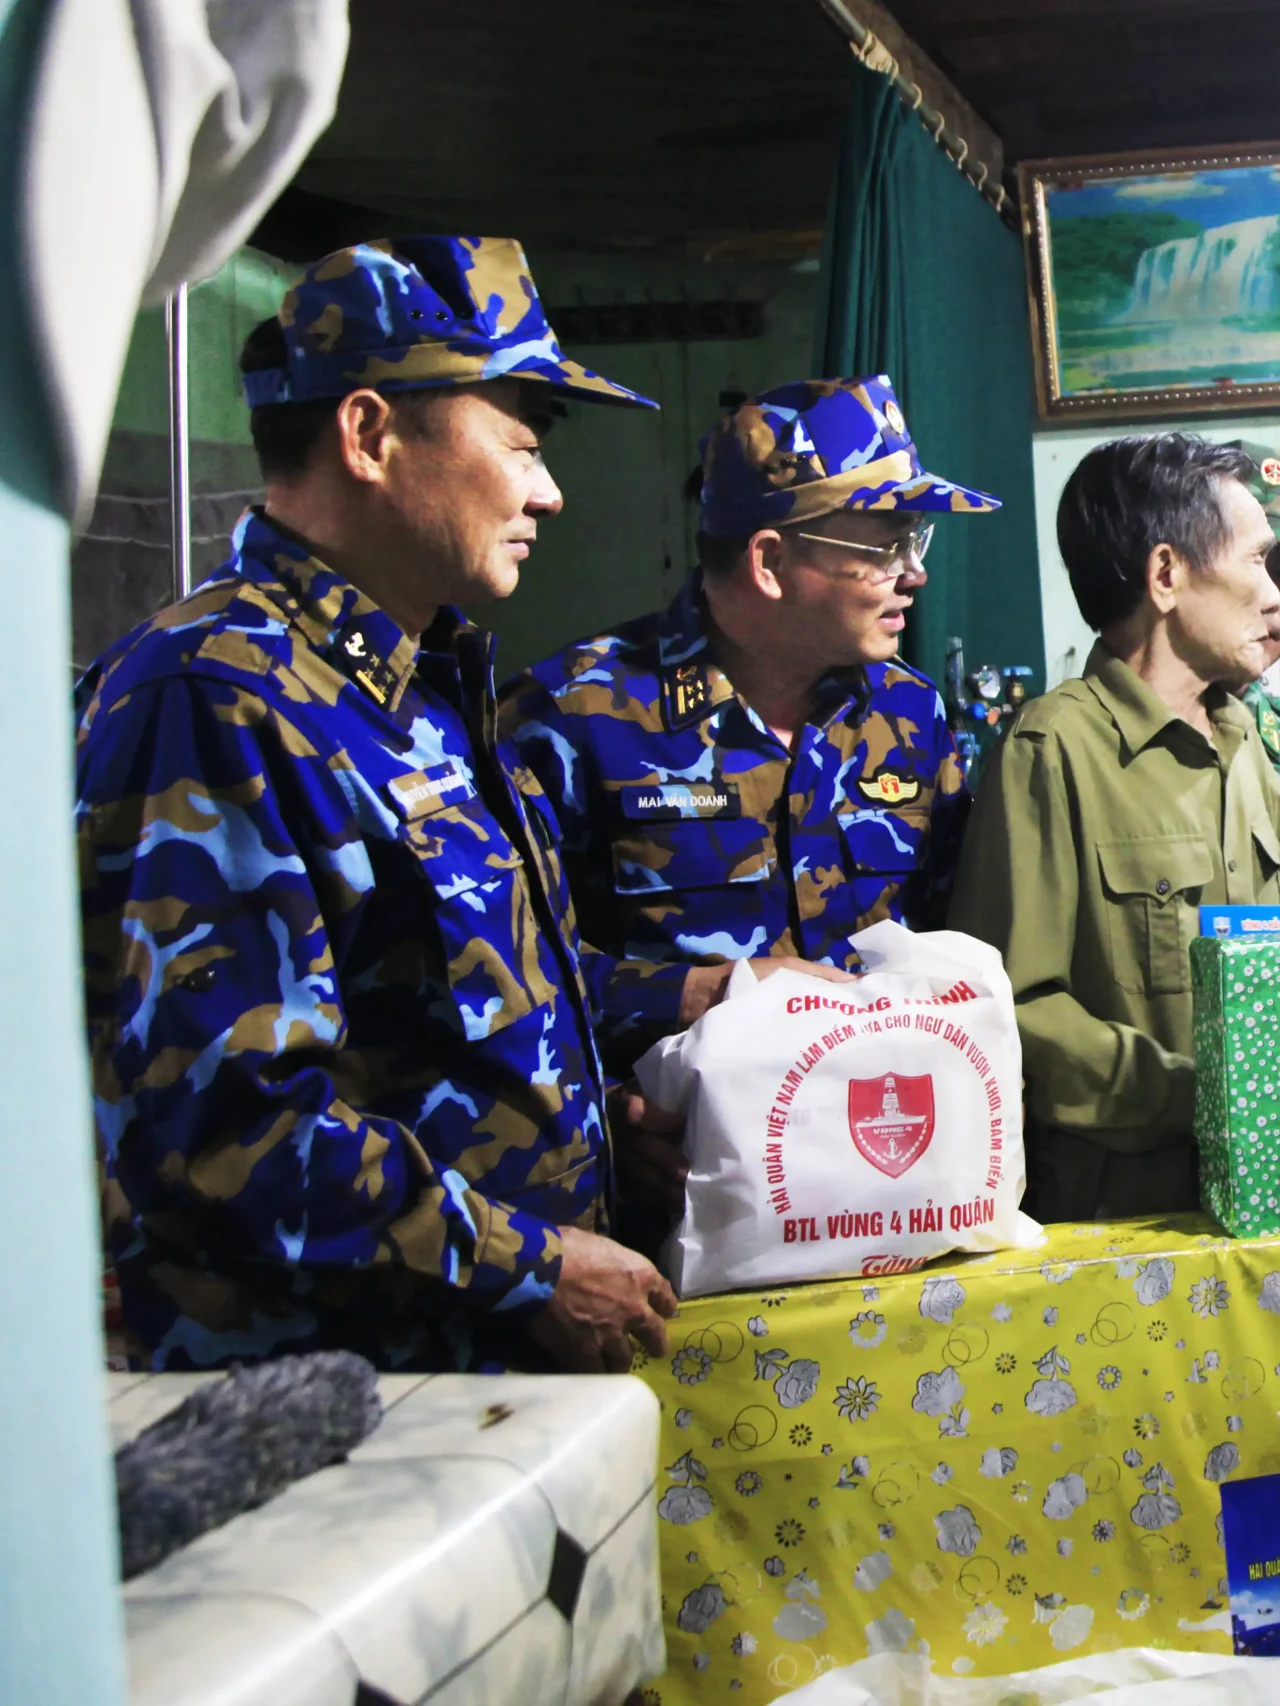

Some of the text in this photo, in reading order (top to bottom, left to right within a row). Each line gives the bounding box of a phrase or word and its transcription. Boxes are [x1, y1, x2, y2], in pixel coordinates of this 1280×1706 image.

[638, 796, 661, 808] MAI
[690, 795, 728, 807] DOANH
[884, 1013, 911, 1029] CHO
[915, 1012, 944, 1035] NGƯ
[821, 1023, 857, 1051] ĐIỂM
[943, 1022, 969, 1051] DÂN
[795, 1041, 826, 1074] LÀM
[966, 1041, 991, 1079] VƯƠN
[776, 1069, 804, 1106] NAM
[766, 1106, 790, 1137] VIỆT
[762, 1143, 786, 1184] QUÂN
[766, 1187, 792, 1215] HẢI
[783, 1195, 995, 1243] BTL VÙNG 4 HẢI QUÂN
